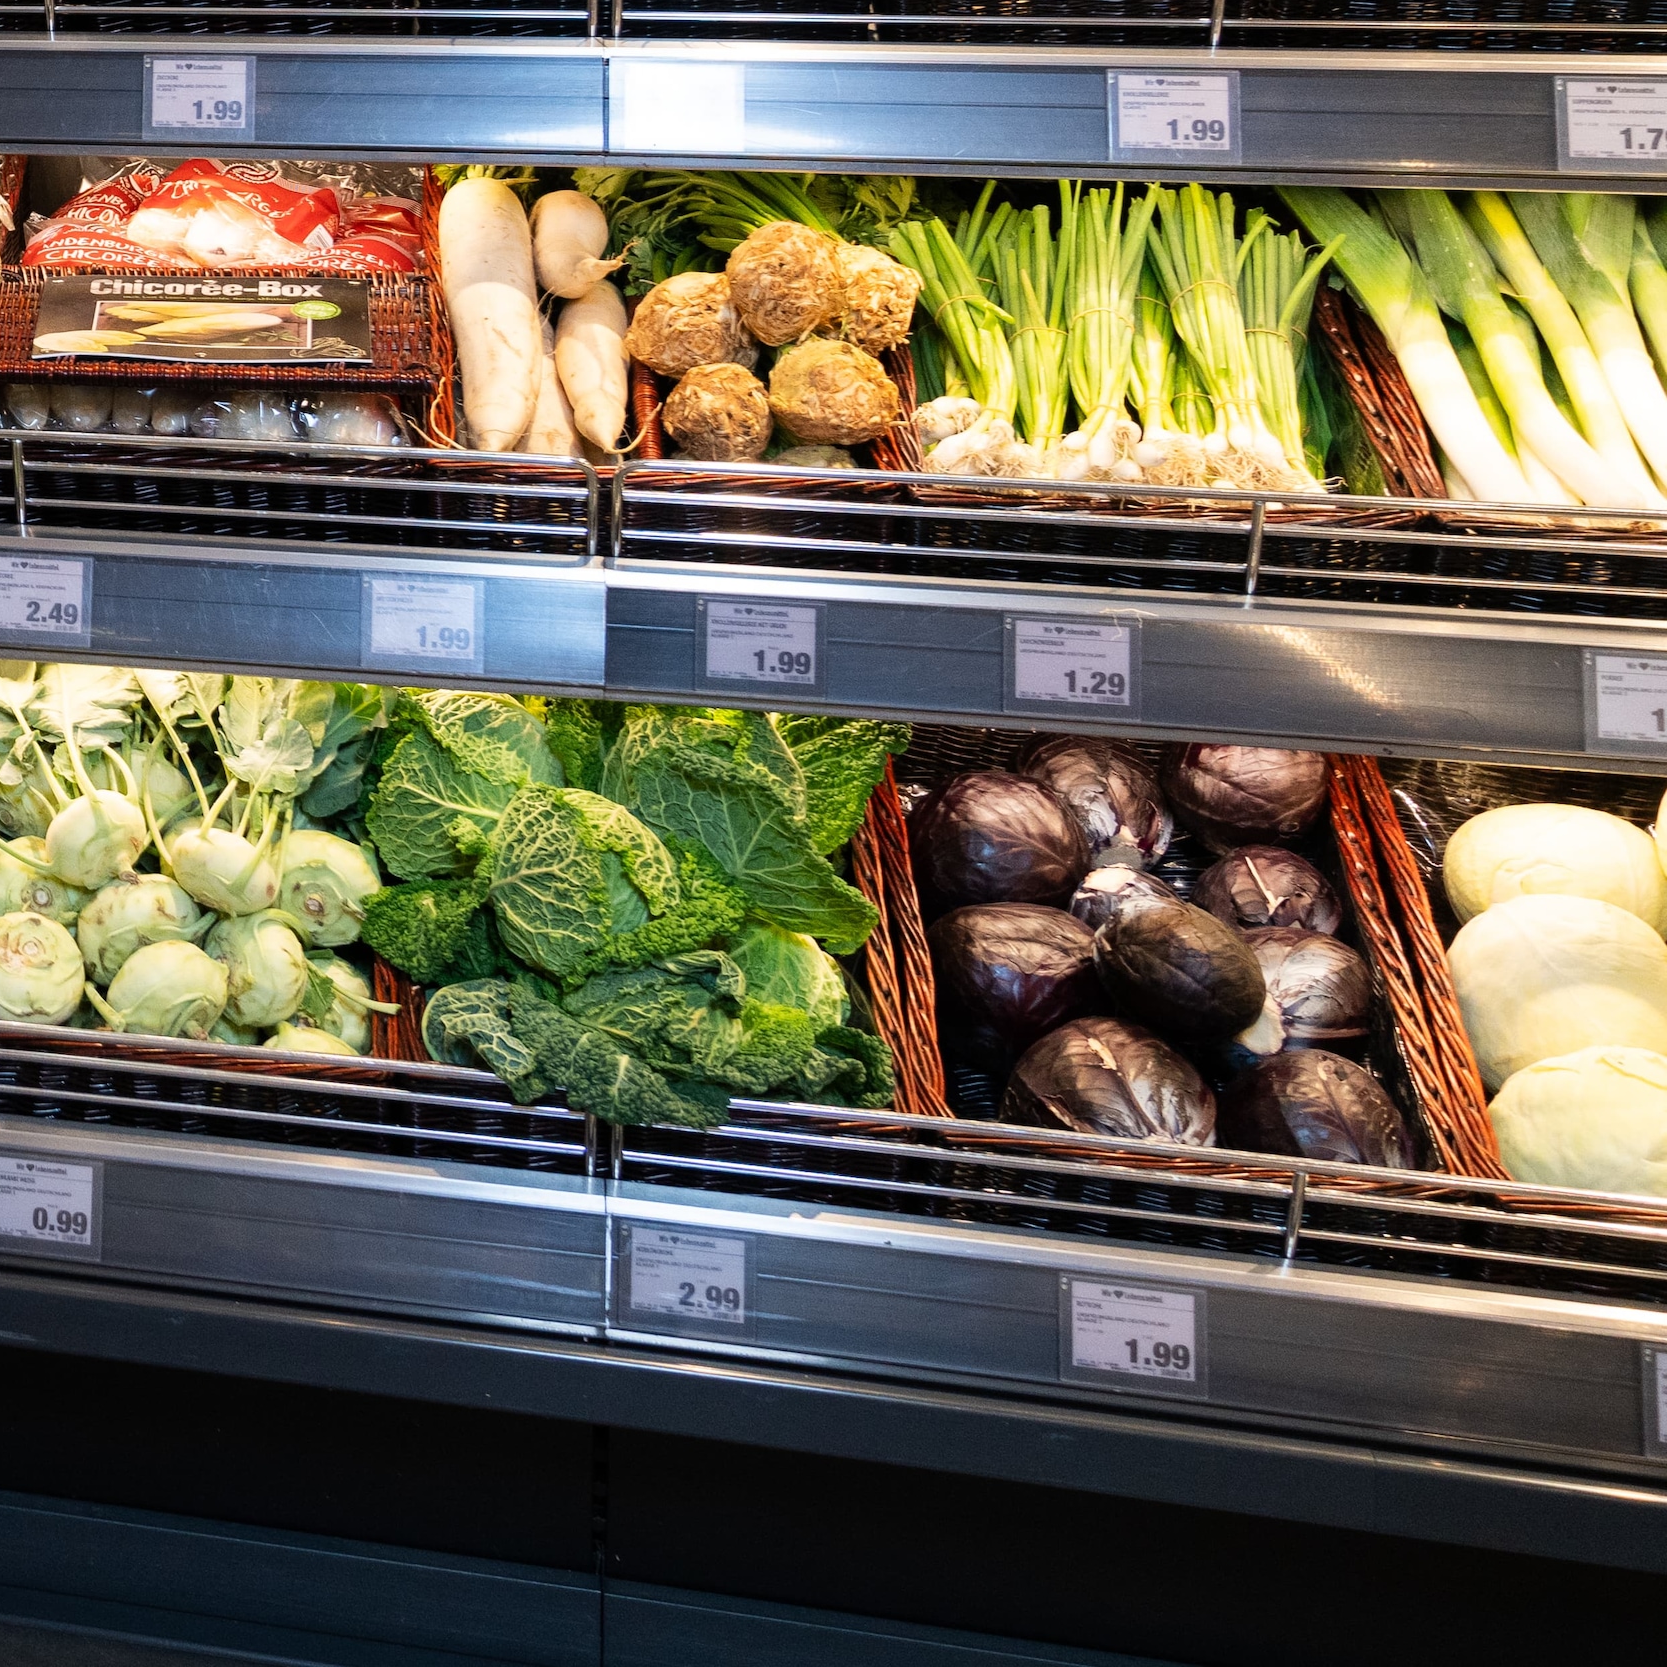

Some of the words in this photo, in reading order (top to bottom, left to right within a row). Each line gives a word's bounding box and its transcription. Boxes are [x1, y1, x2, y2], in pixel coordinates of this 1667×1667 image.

[192, 100, 243, 120] 1.99
[1166, 119, 1225, 141] 1.99
[1619, 127, 1667, 150] 1.7
[89, 278, 323, 298] Chicorée-Box
[26, 600, 79, 624] 2.49
[417, 625, 471, 650] 1.99
[753, 649, 811, 675] 1.99
[1064, 669, 1125, 696] 1.29
[32, 1206, 88, 1235] 0.99
[679, 1282, 740, 1311] 2.99
[1124, 1339, 1189, 1369] 1.99
